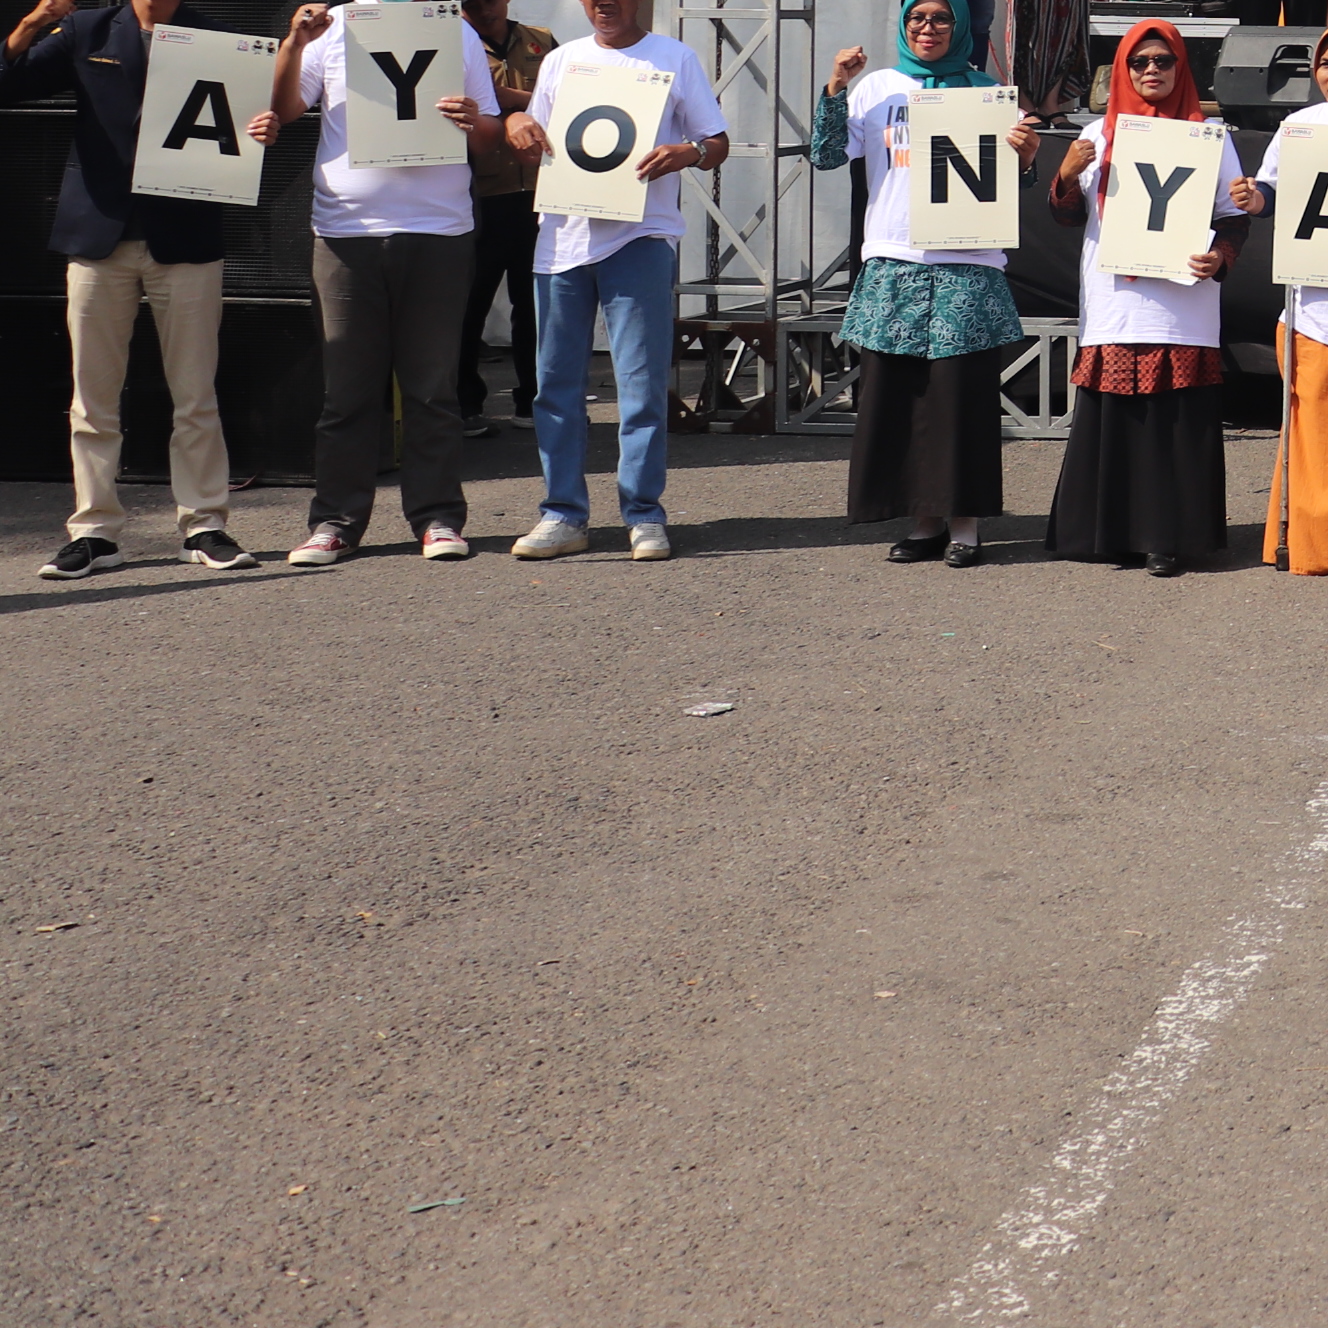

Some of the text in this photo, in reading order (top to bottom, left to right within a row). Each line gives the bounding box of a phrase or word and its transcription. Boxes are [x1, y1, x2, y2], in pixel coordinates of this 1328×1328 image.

[162, 80, 240, 156] A
[369, 50, 438, 120] Y
[566, 105, 637, 173] O
[931, 135, 996, 203] N
[1135, 163, 1196, 231] Y
